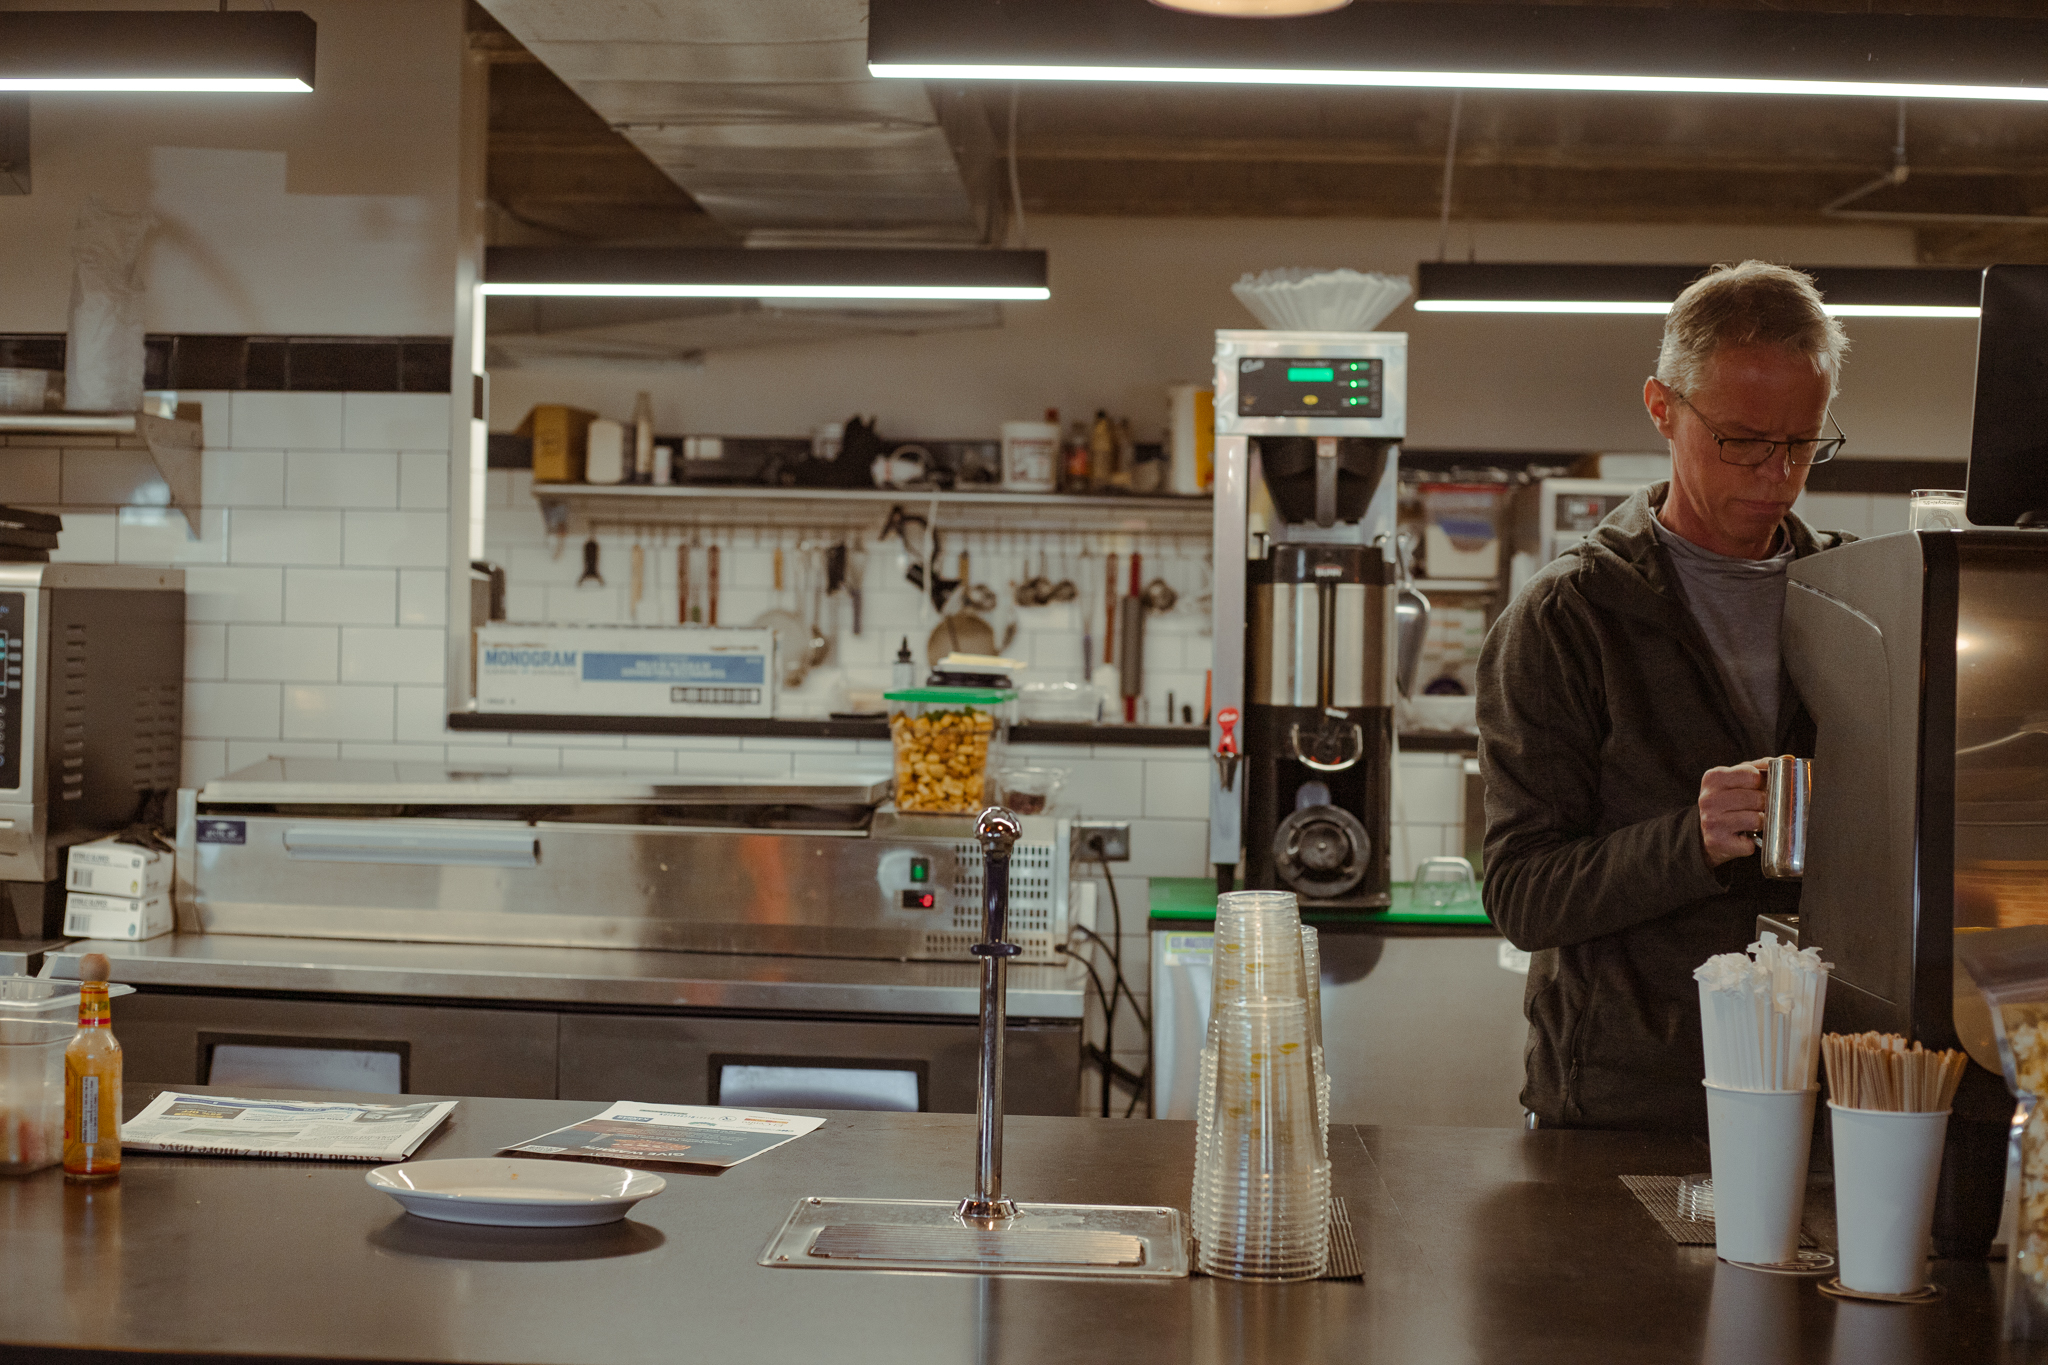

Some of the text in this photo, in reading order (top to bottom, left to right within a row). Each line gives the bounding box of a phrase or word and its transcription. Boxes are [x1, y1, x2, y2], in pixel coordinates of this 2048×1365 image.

[484, 650, 577, 667] MONOGRAM
[159, 1142, 195, 1153] days
[198, 1146, 240, 1155] more
